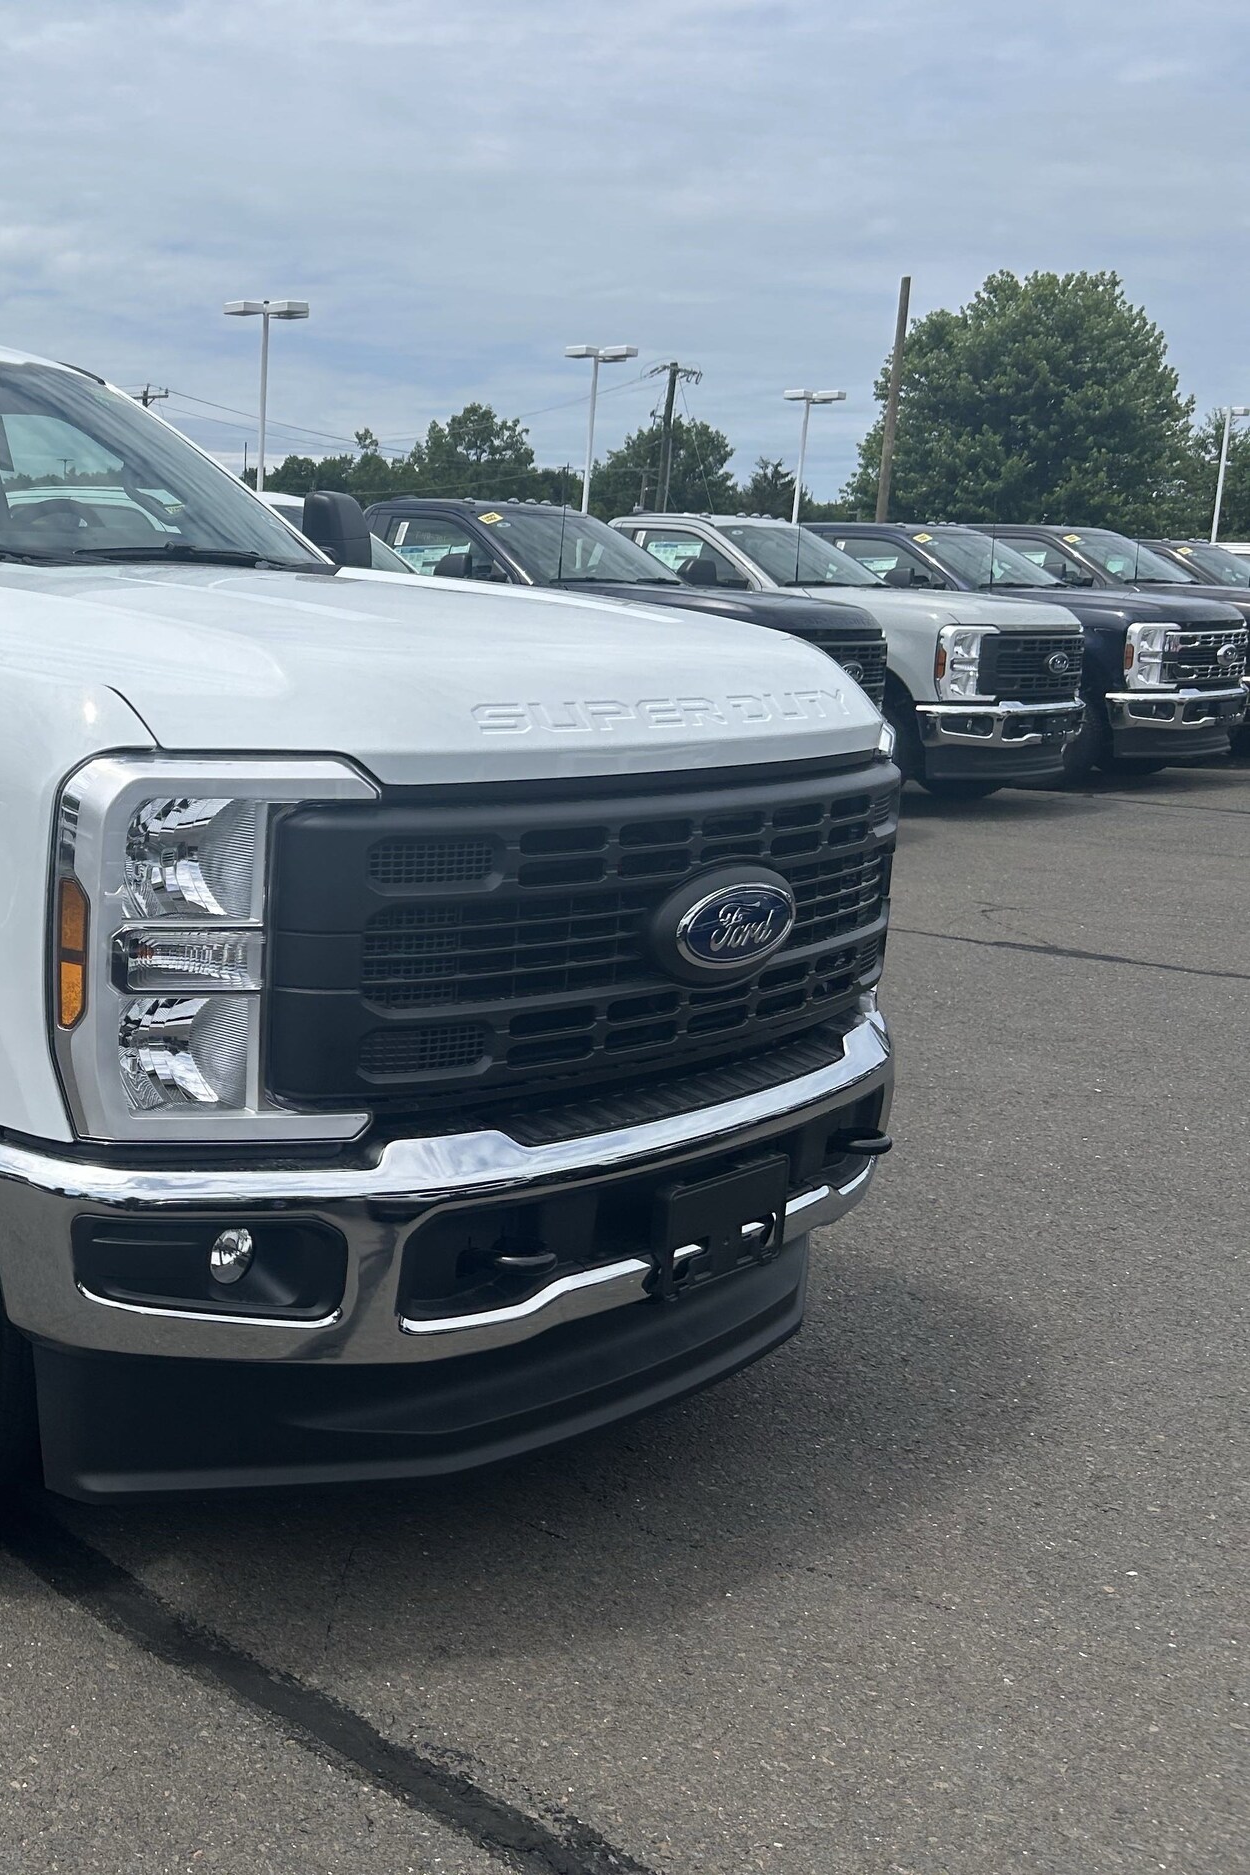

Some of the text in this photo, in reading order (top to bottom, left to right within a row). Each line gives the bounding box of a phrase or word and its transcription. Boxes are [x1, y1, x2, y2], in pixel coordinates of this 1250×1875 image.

[471, 689, 851, 735] SUPER DUTY
[710, 901, 776, 952] Ford
